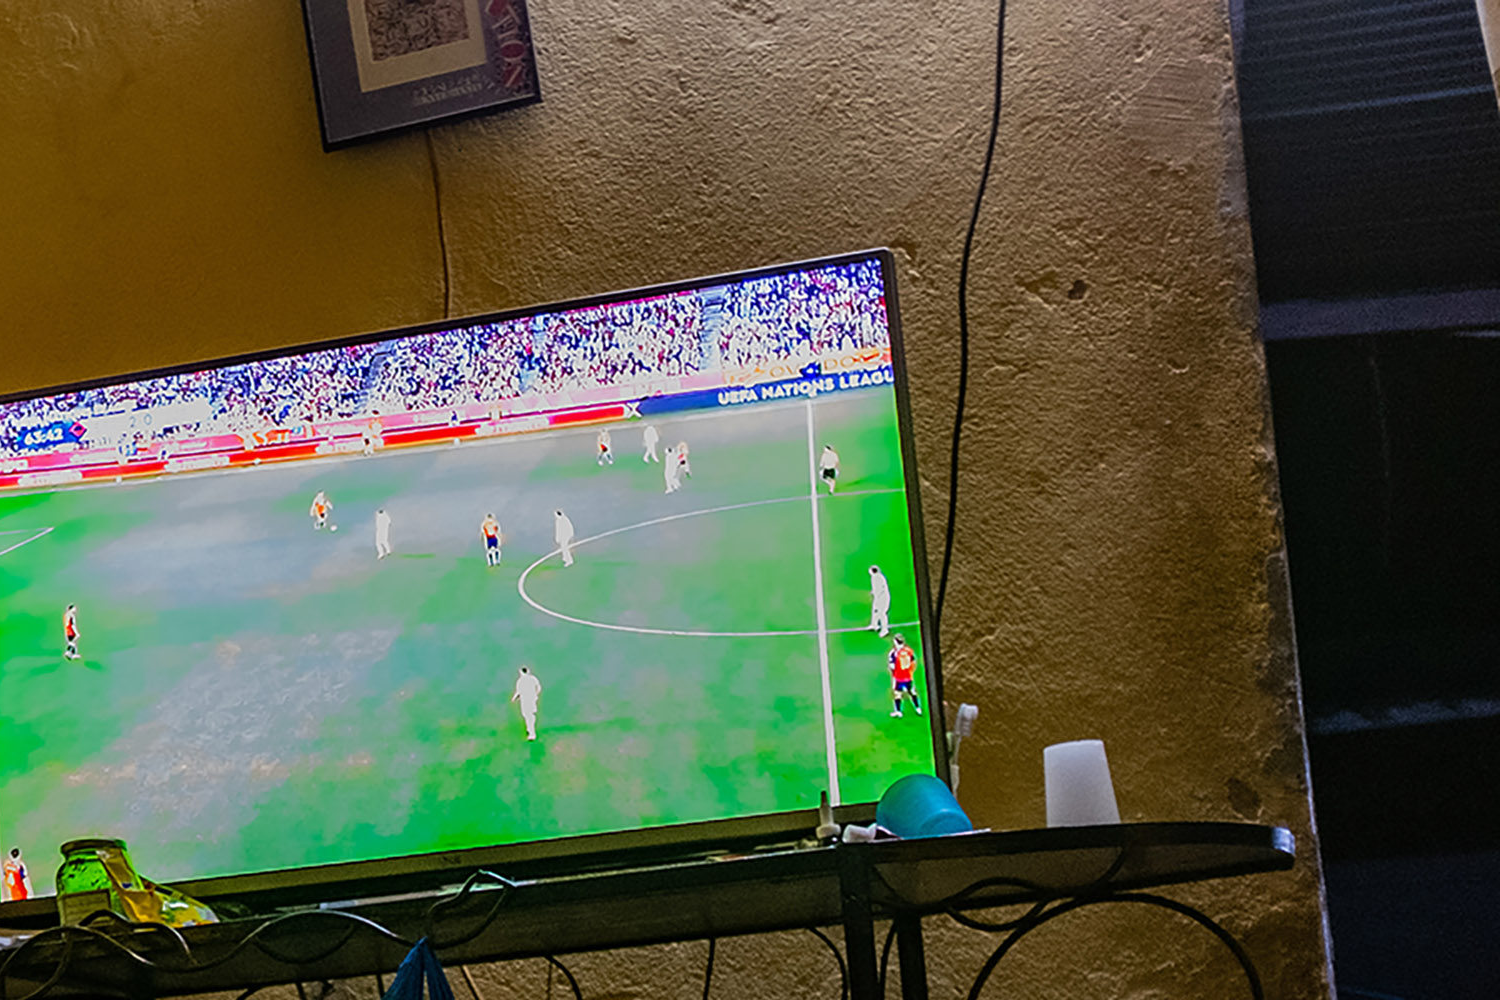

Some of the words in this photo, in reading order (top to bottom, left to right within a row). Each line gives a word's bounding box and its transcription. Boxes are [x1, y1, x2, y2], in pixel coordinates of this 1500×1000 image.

[718, 388, 758, 405] UEFA
[761, 378, 835, 400] NATIONS
[839, 369, 894, 389] LEAGU
